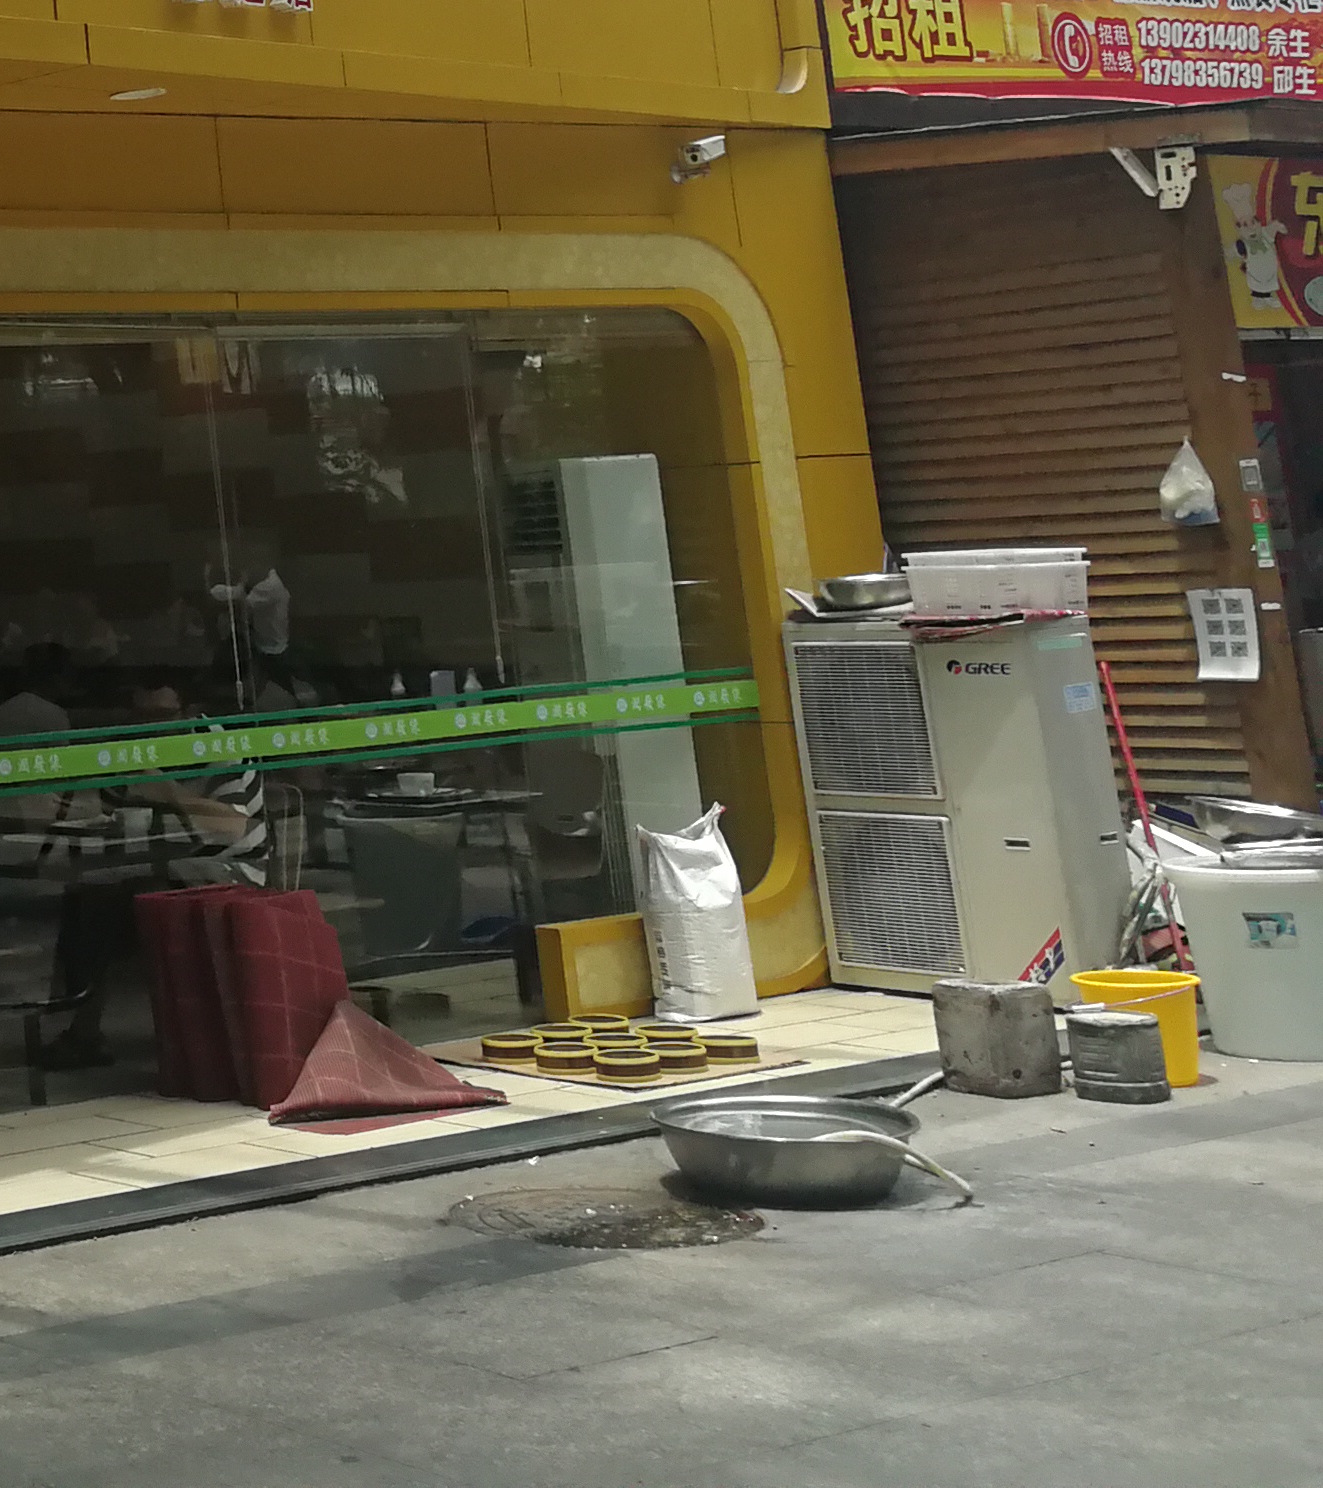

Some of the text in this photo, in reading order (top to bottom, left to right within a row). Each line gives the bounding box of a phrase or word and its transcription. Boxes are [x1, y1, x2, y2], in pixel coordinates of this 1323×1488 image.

[1097, 23, 1130, 47] 招租
[1137, 20, 1310, 58] 13902314408 余生
[1100, 51, 1134, 74] 热线
[1141, 58, 1317, 96] 13798356739 邱生
[964, 662, 1012, 675] GREE
